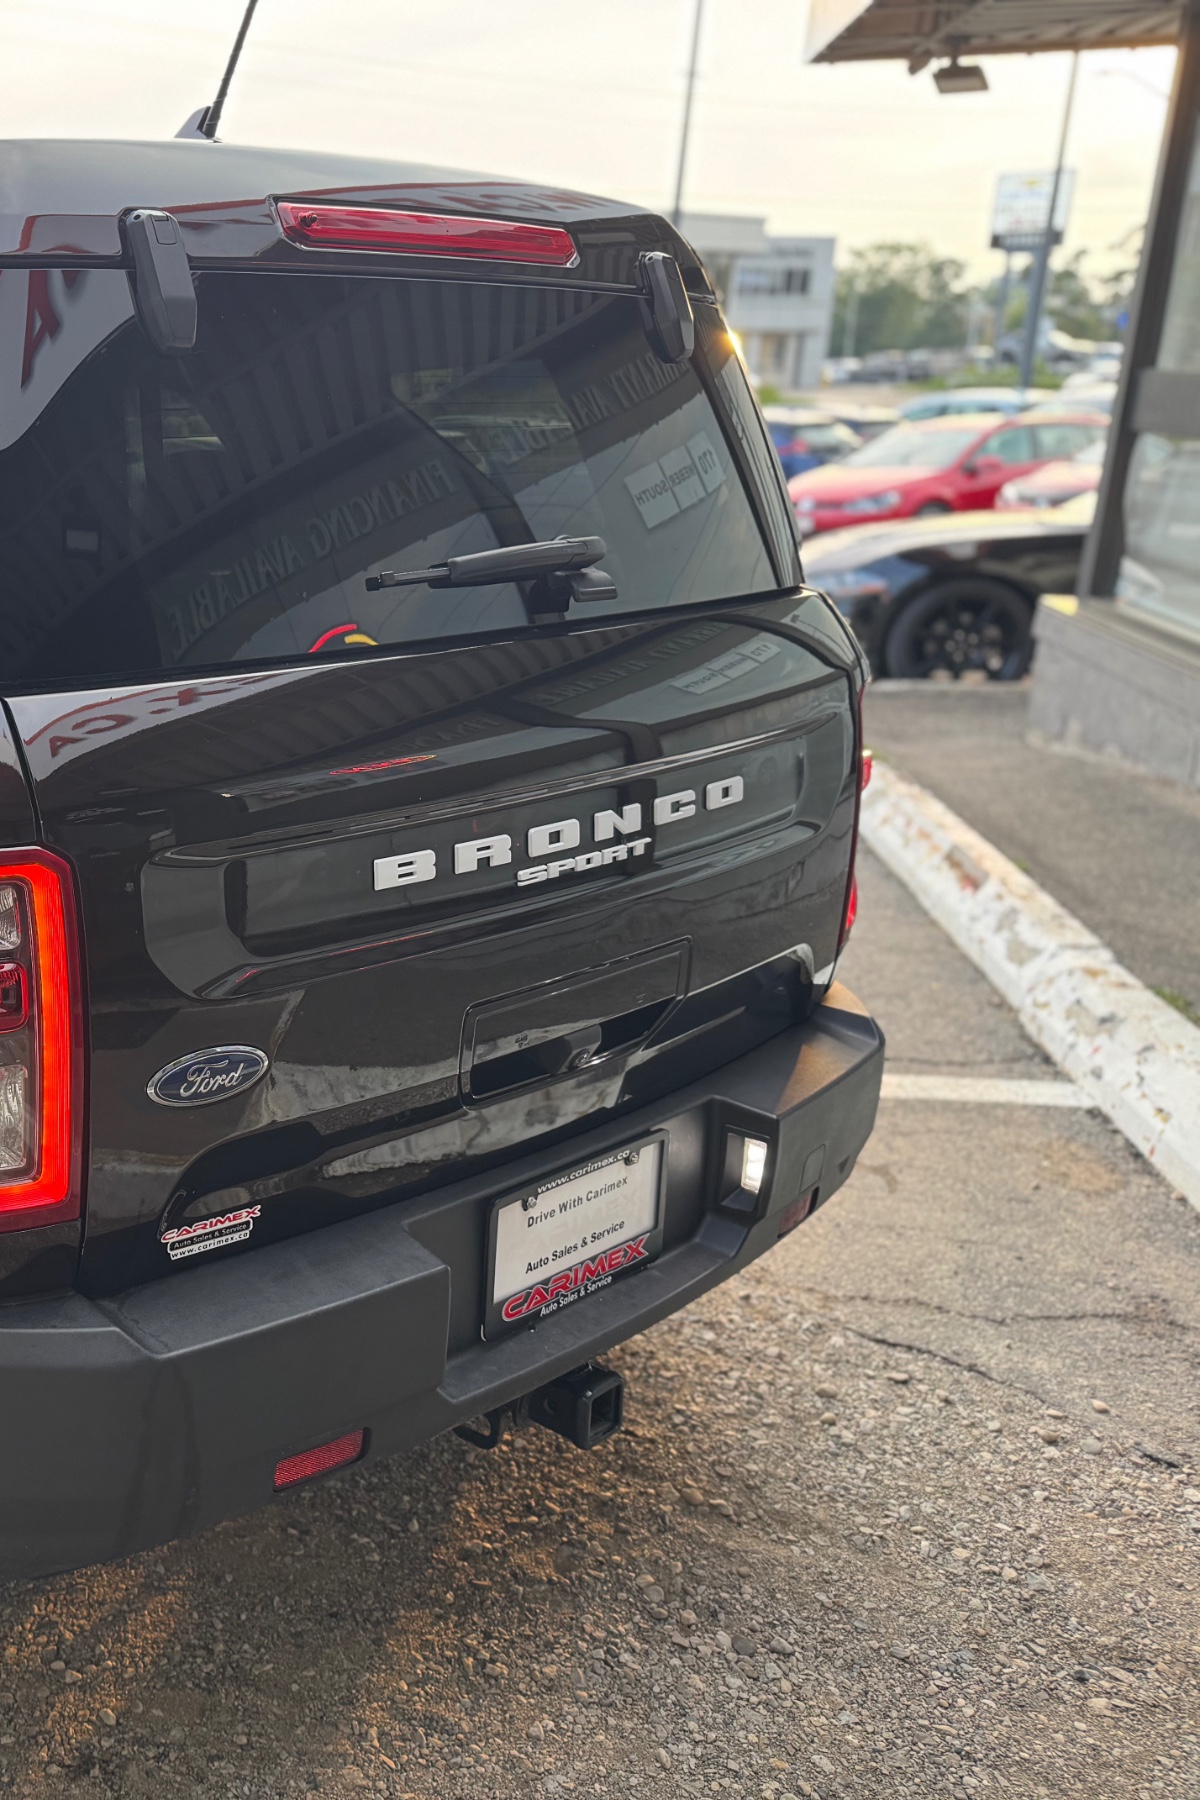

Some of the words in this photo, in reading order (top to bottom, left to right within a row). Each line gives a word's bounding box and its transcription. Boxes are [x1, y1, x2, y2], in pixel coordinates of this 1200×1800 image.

[373, 775, 744, 891] BRONCO
[517, 837, 652, 887] SPORT
[179, 1059, 245, 1098] Ford
[537, 1149, 631, 1194] www.carimex.ca
[161, 1205, 261, 1241] CARIMEX
[527, 1209, 556, 1229] Drive
[558, 1195, 583, 1214] With
[586, 1175, 628, 1202] Carimex
[171, 1231, 248, 1259] www.carimex.ca
[173, 1239, 192, 1250] Auto
[193, 1233, 213, 1243] Sales
[221, 1224, 247, 1236] Service
[525, 1254, 550, 1274] Auto
[551, 1243, 578, 1262] Sales
[580, 1237, 588, 1248] &
[590, 1219, 625, 1244] Service
[502, 1233, 650, 1322] CARIMEX
[540, 1301, 558, 1317] Auto
[559, 1291, 578, 1308] Sales
[579, 1286, 586, 1297] &
[587, 1275, 612, 1293] Service
